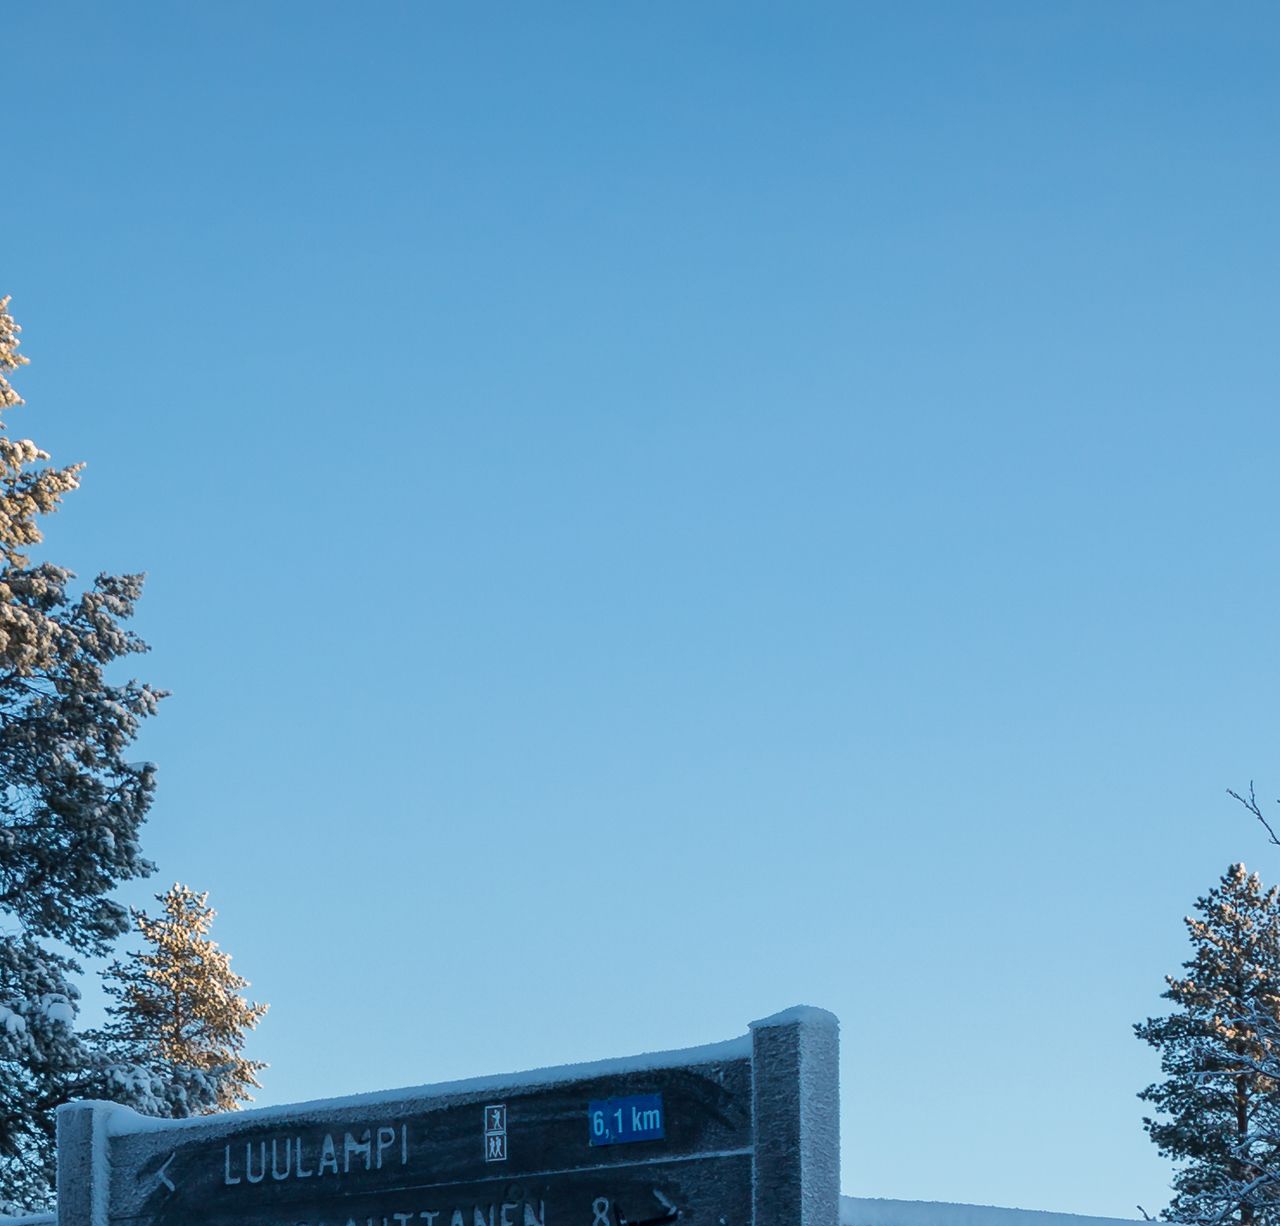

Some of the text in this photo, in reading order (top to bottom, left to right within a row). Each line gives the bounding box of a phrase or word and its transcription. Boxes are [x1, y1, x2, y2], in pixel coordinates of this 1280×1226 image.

[223, 1106, 660, 1185] LUULAMPI 6,1 km
